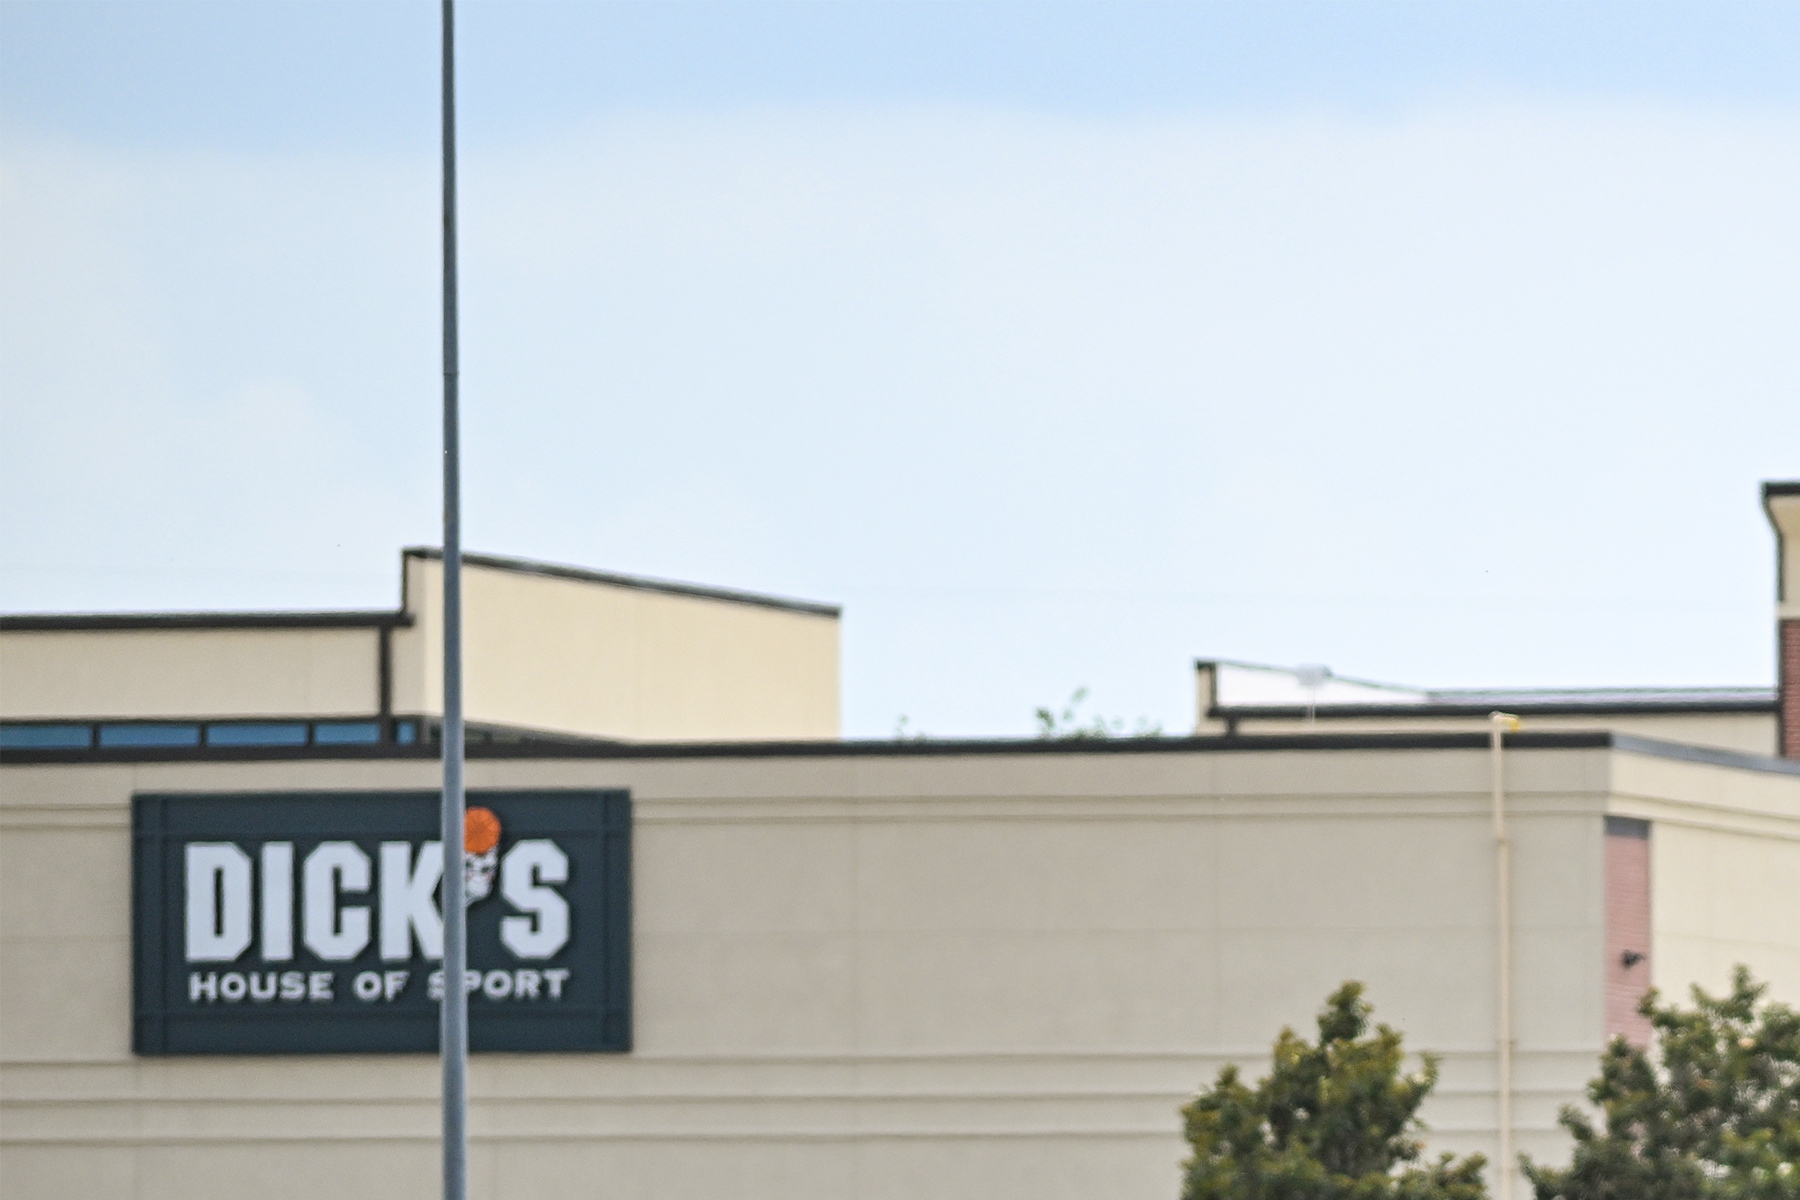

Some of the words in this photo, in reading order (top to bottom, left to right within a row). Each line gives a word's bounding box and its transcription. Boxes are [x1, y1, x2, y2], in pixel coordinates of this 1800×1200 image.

[185, 806, 570, 961] DICK'S
[190, 971, 334, 1001] HOUSE
[354, 970, 410, 1000] OF
